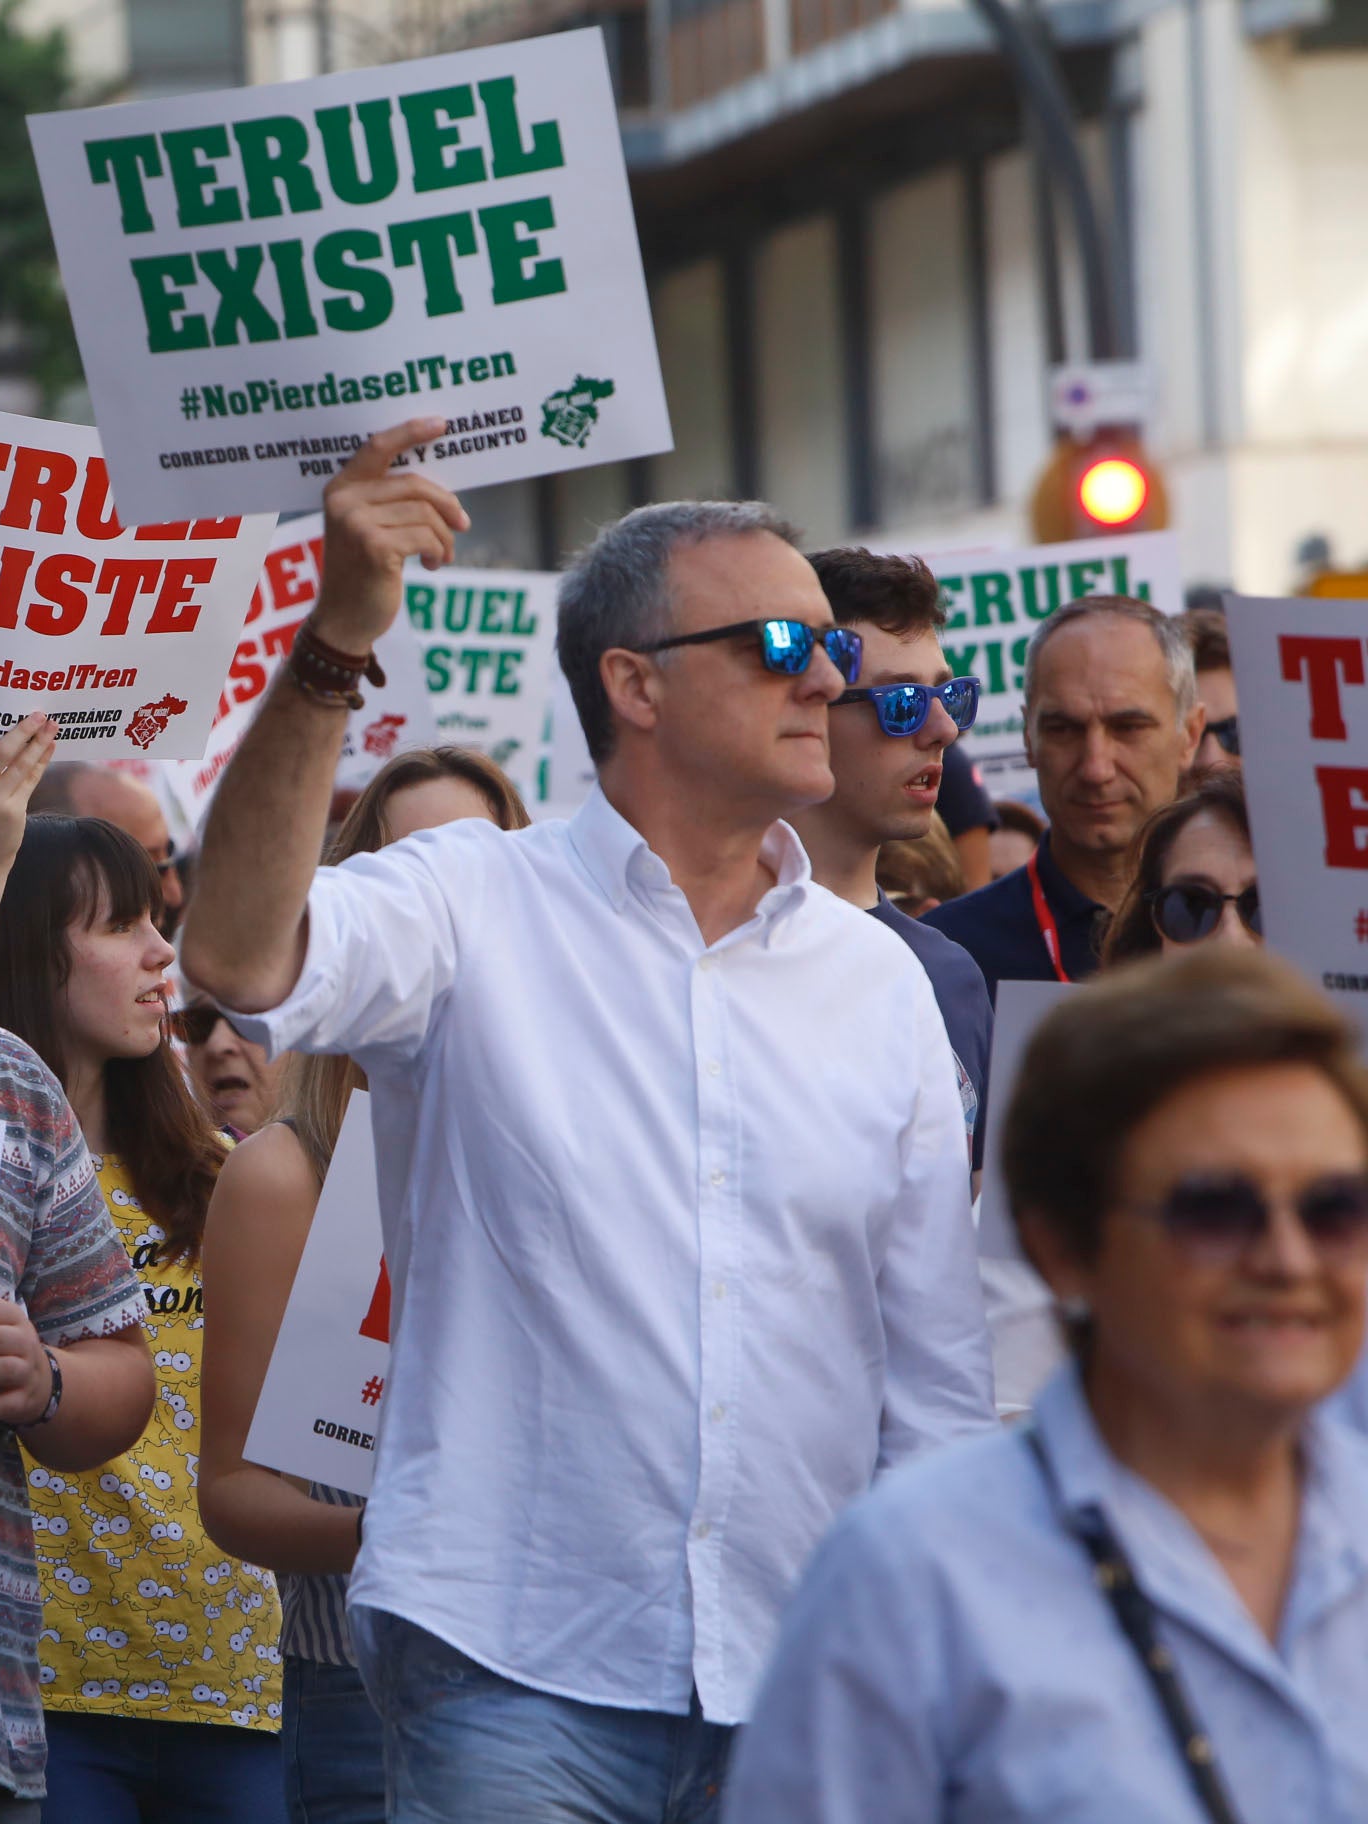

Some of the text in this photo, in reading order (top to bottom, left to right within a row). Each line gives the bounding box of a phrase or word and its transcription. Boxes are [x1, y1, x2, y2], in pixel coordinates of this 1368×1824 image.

[85, 75, 565, 235] TERUEL
[130, 195, 567, 354] EXISTE
[180, 351, 518, 421] #NoPierdaselTren
[159, 446, 251, 470] CORREDOR
[300, 460, 333, 477] POR
[414, 447, 428, 464] Y
[434, 428, 527, 460] SAGUNTO
[1276, 633, 1368, 742] T
[313, 1418, 376, 1451] CORRE
